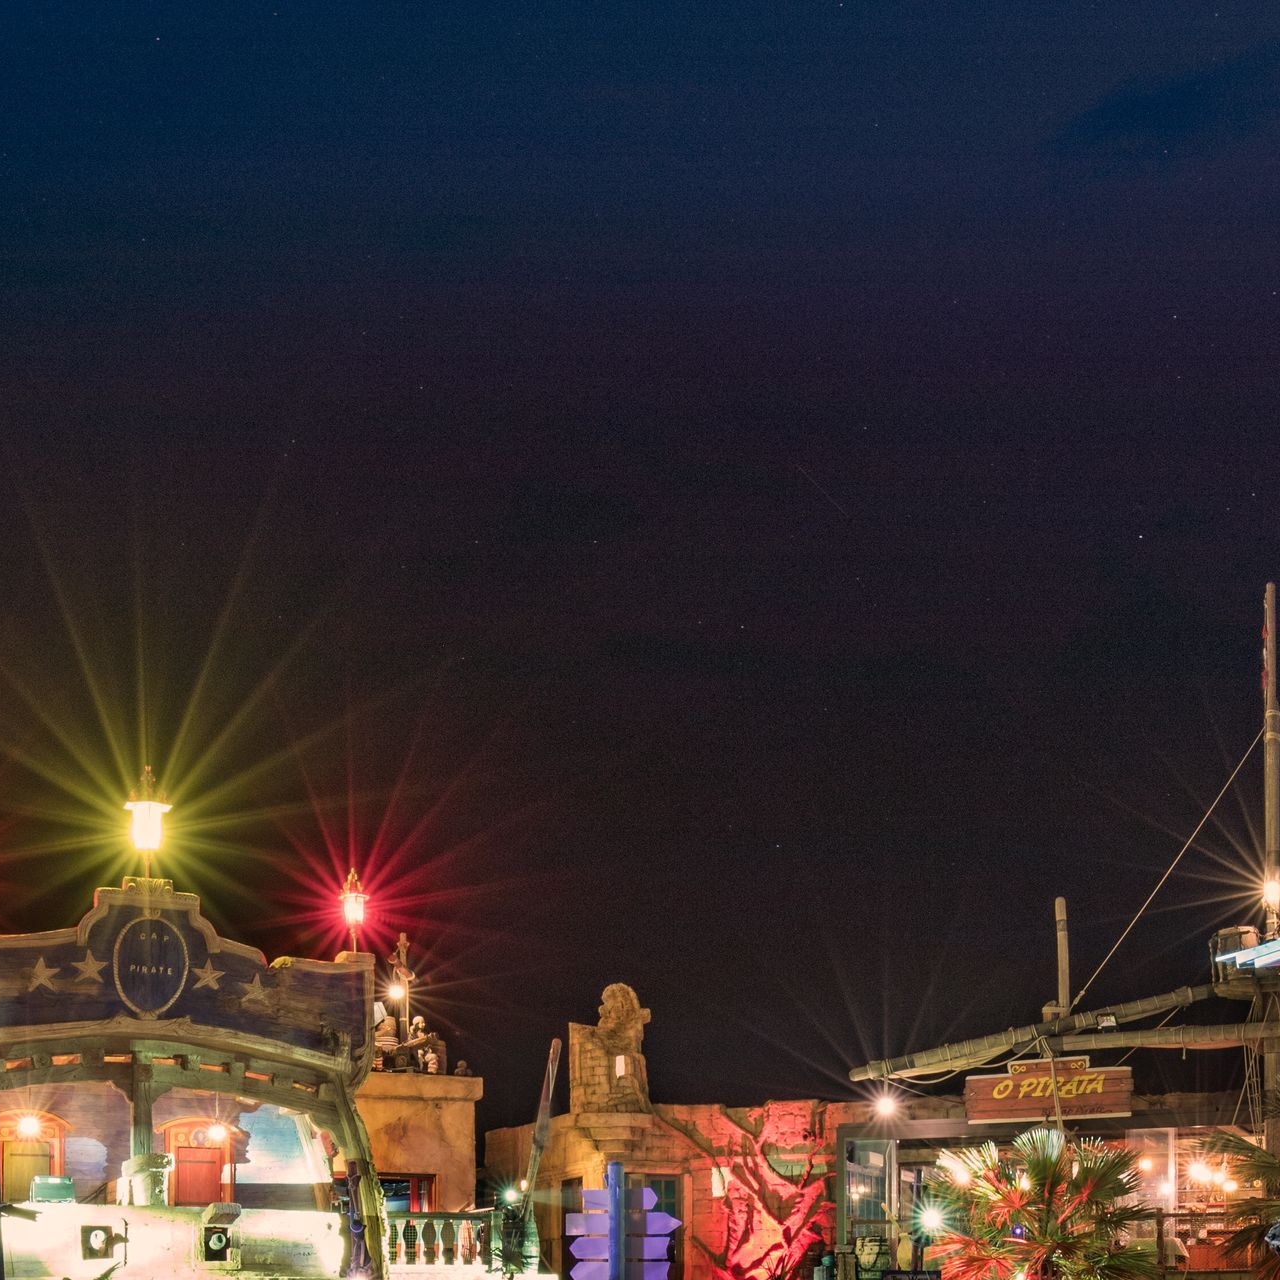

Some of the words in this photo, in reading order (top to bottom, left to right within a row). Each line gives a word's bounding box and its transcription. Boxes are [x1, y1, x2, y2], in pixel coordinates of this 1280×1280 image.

[140, 932, 170, 942] CAP
[129, 964, 174, 976] PIRATE
[992, 1079, 1015, 1100] O
[1018, 1073, 1106, 1100] PIRATA
